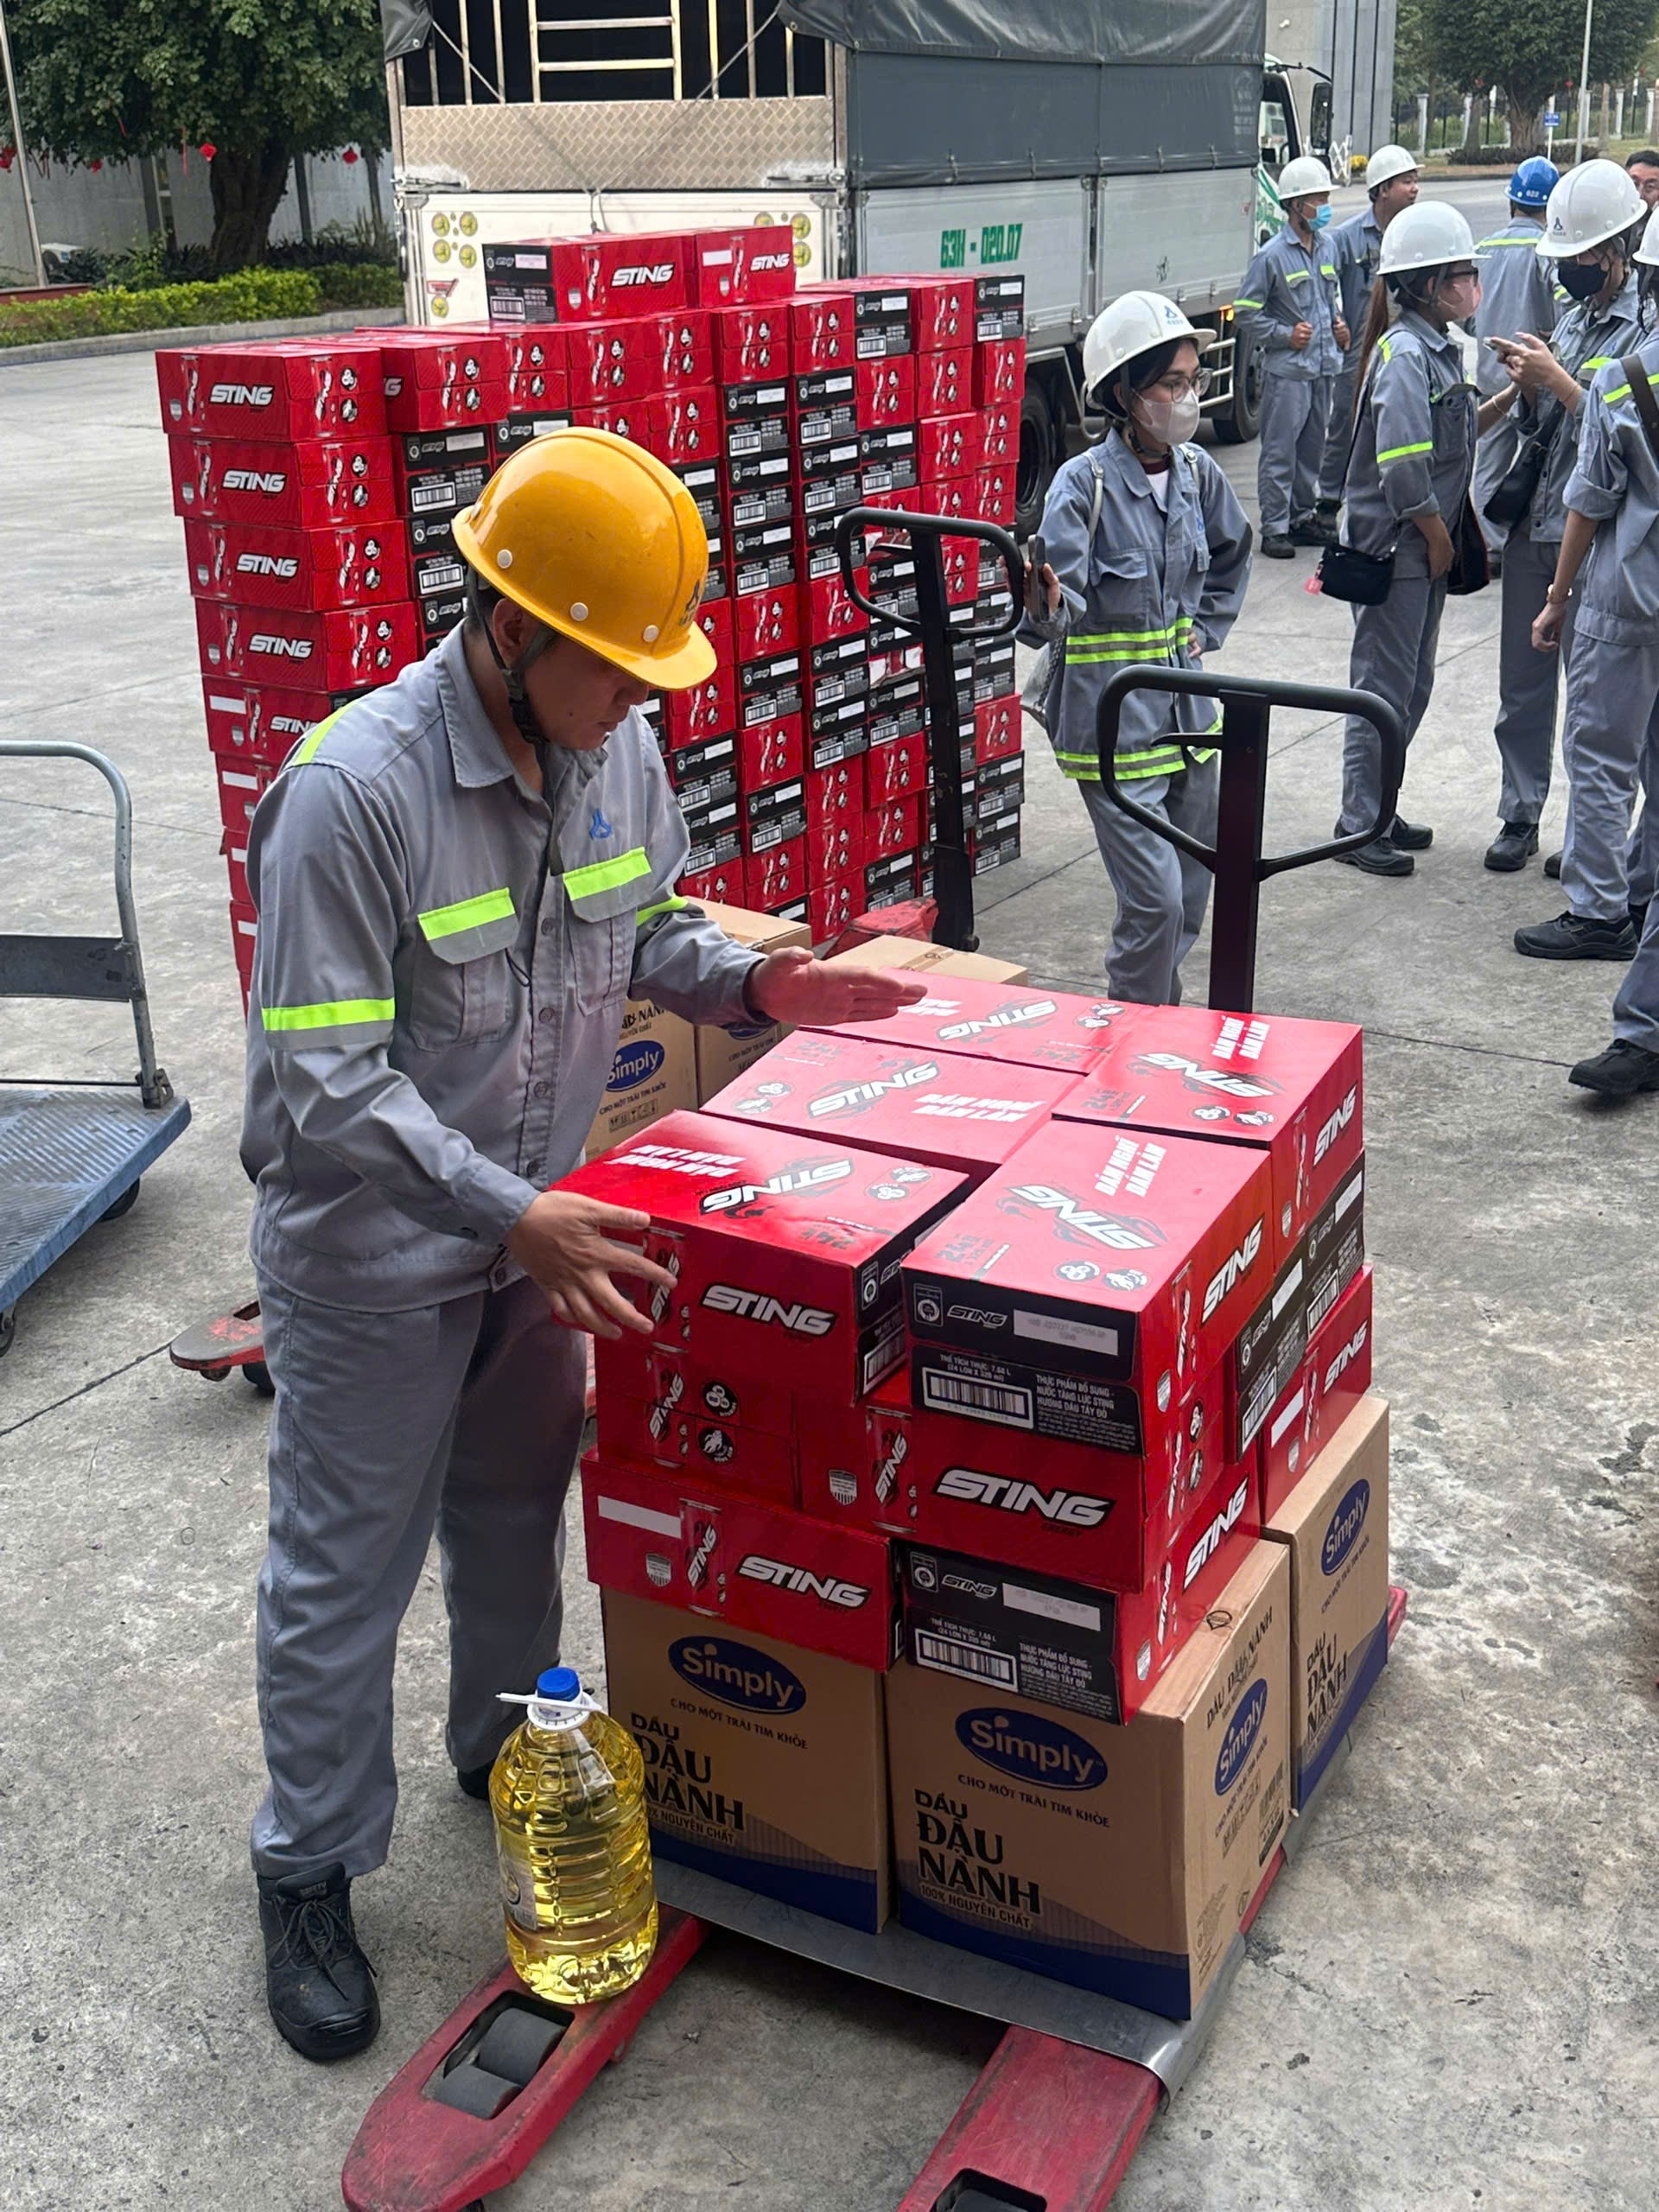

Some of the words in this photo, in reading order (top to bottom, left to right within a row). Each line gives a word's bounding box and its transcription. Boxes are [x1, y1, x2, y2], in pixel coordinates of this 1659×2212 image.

[611, 264, 674, 288] STING
[750, 252, 791, 272] STING
[210, 384, 274, 406] STING
[222, 469, 286, 493] STING
[236, 554, 298, 577] STING
[249, 634, 313, 658] STING
[270, 715, 318, 735] STIN
[939, 999, 1056, 1040] STING
[810, 1062, 939, 1117] STING
[1136, 1052, 1274, 1097] STING
[1313, 1084, 1357, 1166] STING
[702, 1160, 851, 1212] STING
[1008, 1185, 1156, 1249] STING
[1202, 1217, 1264, 1325] STING
[702, 1284, 836, 1337] STING
[948, 1306, 1007, 1326] STING
[1323, 1319, 1367, 1395] STING
[874, 1433, 908, 1504] STING
[936, 1469, 1110, 1527] STING
[1183, 1476, 1249, 1590] STING
[1325, 1491, 1367, 1564] Simply
[688, 1524, 718, 1588] STING
[739, 1554, 869, 1609] STING
[942, 1574, 997, 1597] STING
[683, 1643, 794, 1707] Simply
[671, 1698, 696, 1713] CHO
[698, 1706, 722, 1722] MỘT
[753, 1723, 774, 1738] TIM
[1219, 1691, 1264, 1783] Simply
[970, 1715, 1096, 1782] Simply
[645, 1773, 745, 1831] NÀNH
[957, 1773, 986, 1790] CHO
[988, 1782, 1016, 1801] MỘT
[1051, 1800, 1074, 1817] TIM
[916, 1810, 1004, 1865] ĐẬU
[918, 1846, 1041, 1915] NÀNH
[949, 1894, 996, 1918] NGUYÊN
